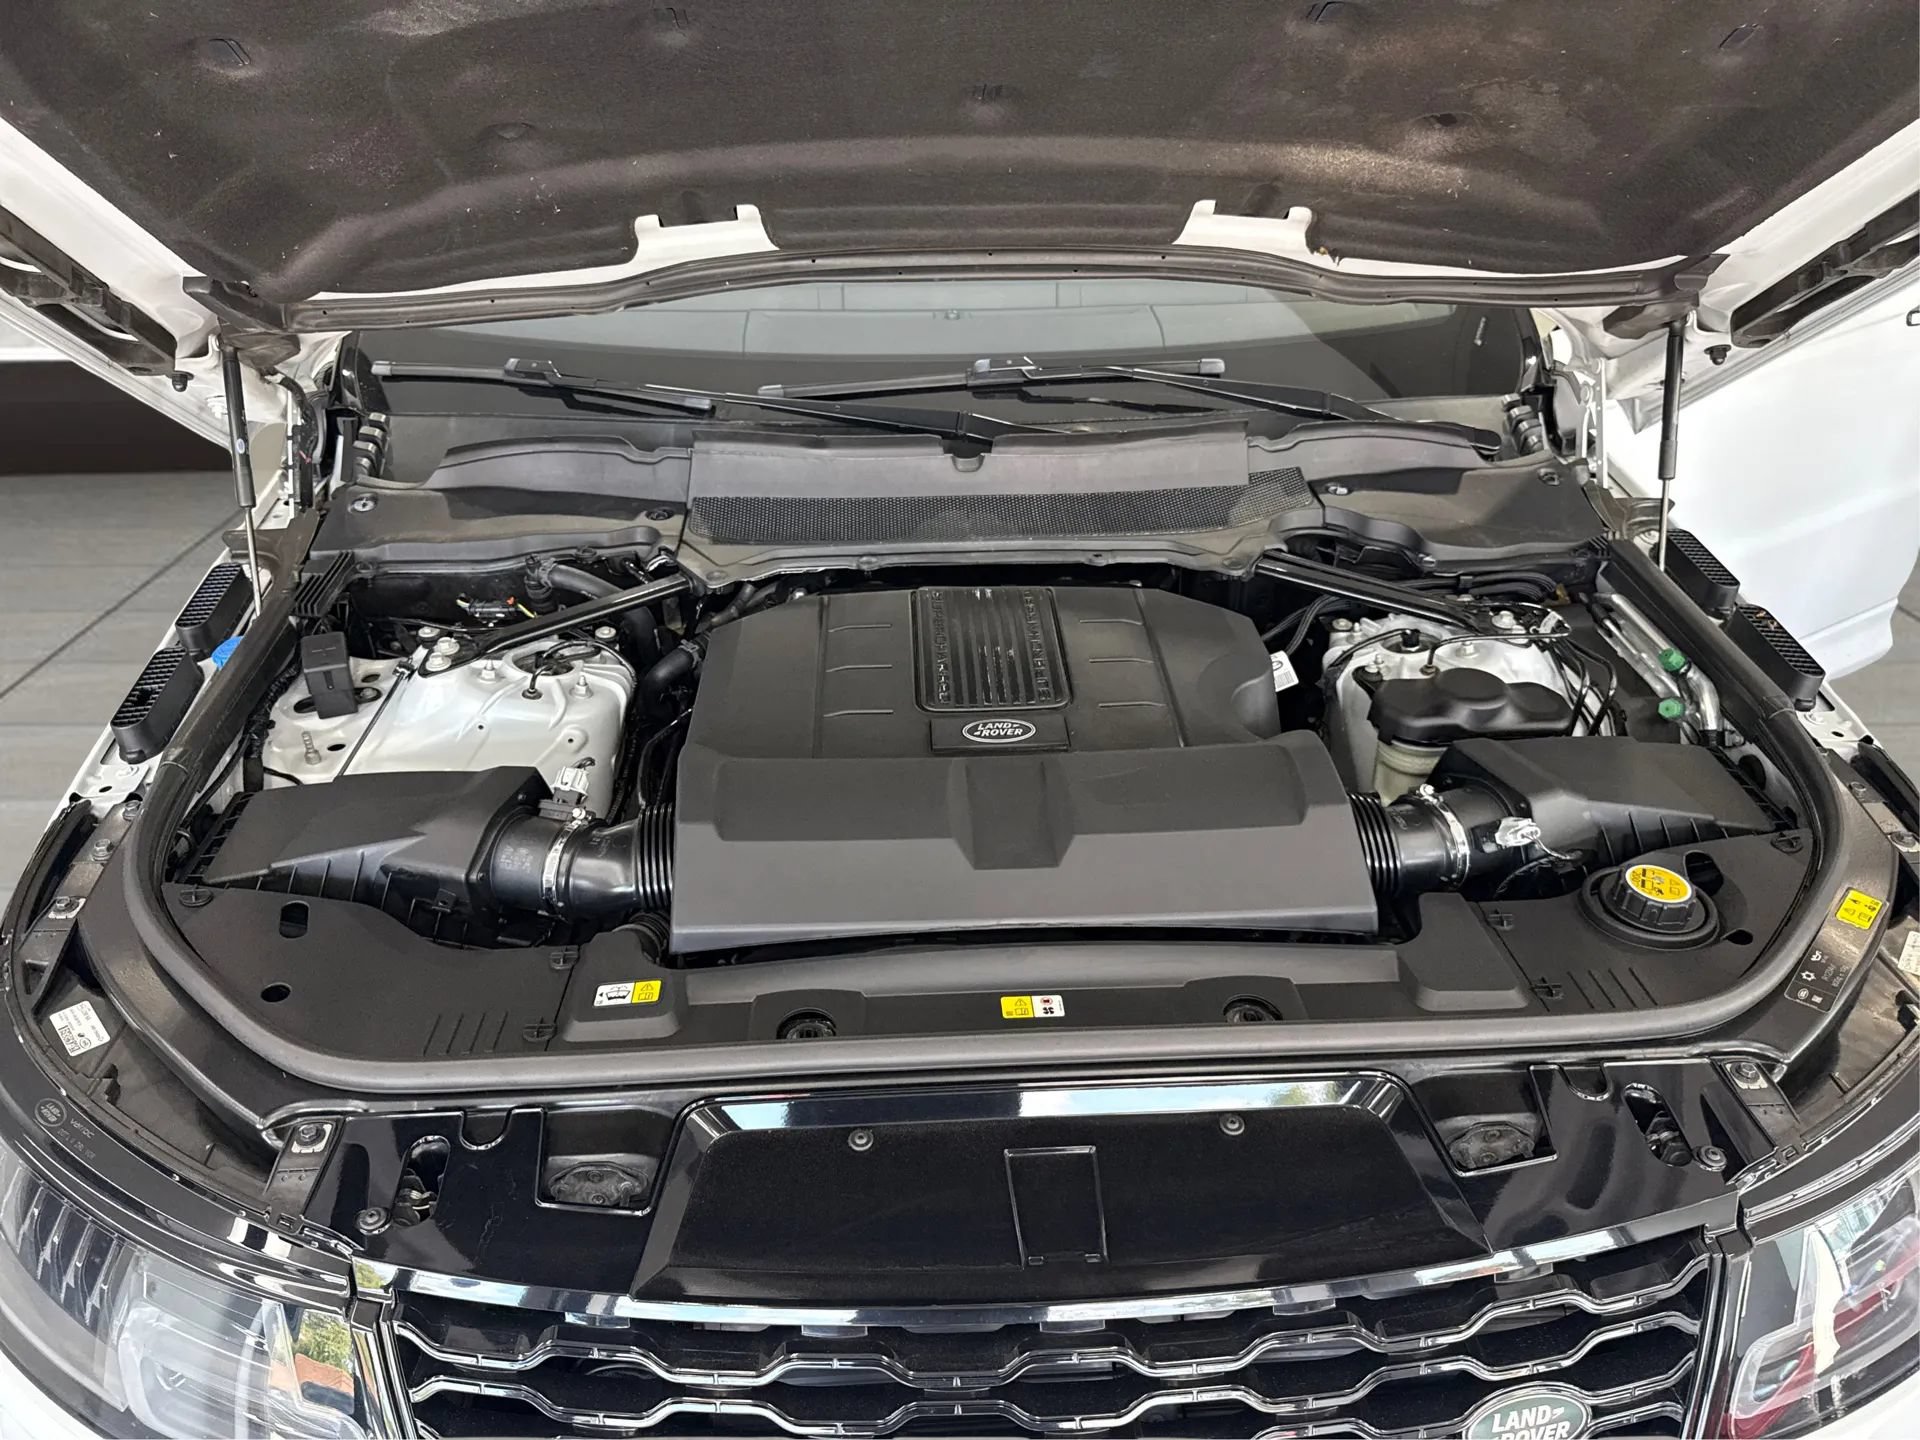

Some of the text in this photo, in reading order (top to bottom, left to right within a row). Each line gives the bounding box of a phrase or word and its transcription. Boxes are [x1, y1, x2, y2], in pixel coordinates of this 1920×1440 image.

[977, 722, 1012, 731] LAND
[981, 728, 1023, 737] ROVER
[1492, 1404, 1551, 1433] LAND
